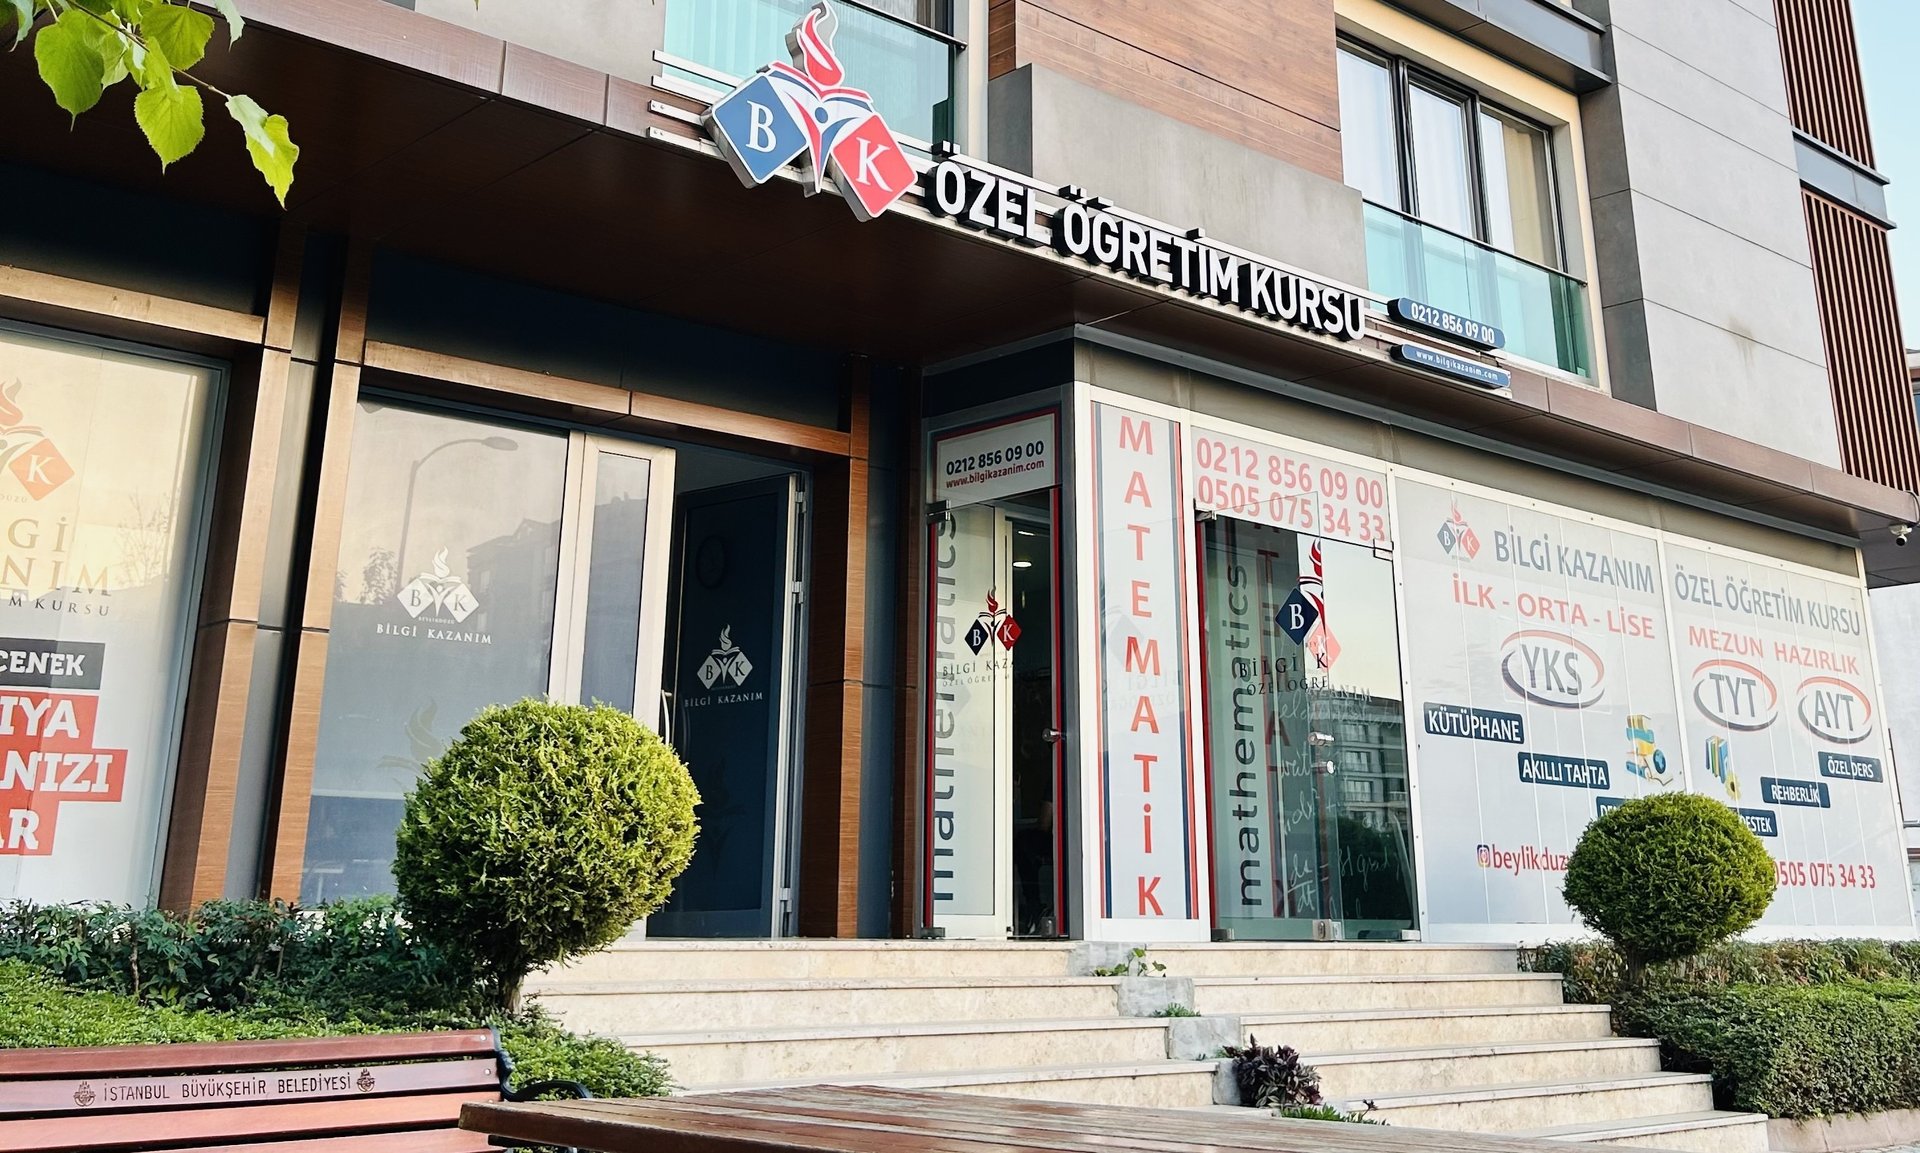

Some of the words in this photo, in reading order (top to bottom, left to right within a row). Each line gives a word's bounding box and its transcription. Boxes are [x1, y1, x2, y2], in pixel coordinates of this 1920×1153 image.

[745, 101, 777, 152] B
[856, 137, 893, 193] K
[936, 140, 1051, 244] ÖZEL
[1063, 184, 1239, 303] ÖĞRETİM
[1250, 262, 1365, 340] KURSU
[1411, 302, 1440, 327] 0212
[1442, 313, 1463, 334] 856
[1465, 320, 1479, 339] 09
[1481, 326, 1495, 344] 00
[1416, 350, 1499, 380] www.bilgikazanim.com
[946, 456, 975, 475] 0212
[978, 450, 1002, 469] 856
[1005, 445, 1022, 463] 09
[1026, 440, 1044, 458] 00
[946, 459, 1045, 489] www.bilgikazanim.com
[1197, 437, 1259, 481] 0212
[1268, 455, 1313, 492] 856
[1319, 467, 1348, 500] 09
[1355, 476, 1383, 509] 00
[1198, 475, 1260, 517] 0505
[1269, 491, 1314, 529] 075
[1323, 503, 1351, 537] 34
[1358, 511, 1386, 542] 33
[1494, 525, 1551, 572] BİLGİ
[1557, 543, 1655, 594] KAZANIM
[35, 598, 110, 617] KURSU
[1289, 603, 1304, 630] B
[1453, 572, 1496, 610] İLK
[1517, 593, 1588, 627] ORTA
[1606, 606, 1656, 639] LİSE
[1675, 564, 1722, 608] ÖZEL
[1725, 575, 1804, 624] ÖĞRETİM
[1807, 600, 1860, 636] KURSU
[377, 622, 417, 637] BİLGİ
[427, 628, 492, 644] KAZANIM
[1689, 625, 1764, 658] MEZUN
[1774, 641, 1860, 676] HAZIRLIK
[1119, 415, 1164, 917] MATEMATİK
[1521, 643, 1582, 696] YKS
[718, 691, 763, 704] KAZANIM
[1709, 672, 1756, 718] TYT
[1814, 690, 1854, 731] AYT
[1221, 564, 1261, 906] mathematics
[1428, 706, 1521, 742] KÜTÜPHANE
[1522, 759, 1562, 782] AKILLI
[1564, 763, 1608, 786] TAHTA
[1828, 756, 1850, 776] ÖZEL
[1851, 760, 1874, 779] DERS
[1771, 783, 1821, 804] REHBERLİK
[1492, 844, 1569, 876] beylikduz
[1810, 862, 1835, 887] 075
[1839, 863, 1856, 888] 34
[1860, 864, 1876, 889] 33
[104, 1083, 170, 1102] İSTANBUL
[182, 1077, 266, 1098] BÜYÜKŞEHİR
[278, 1072, 351, 1094] BELEDİYESİ
